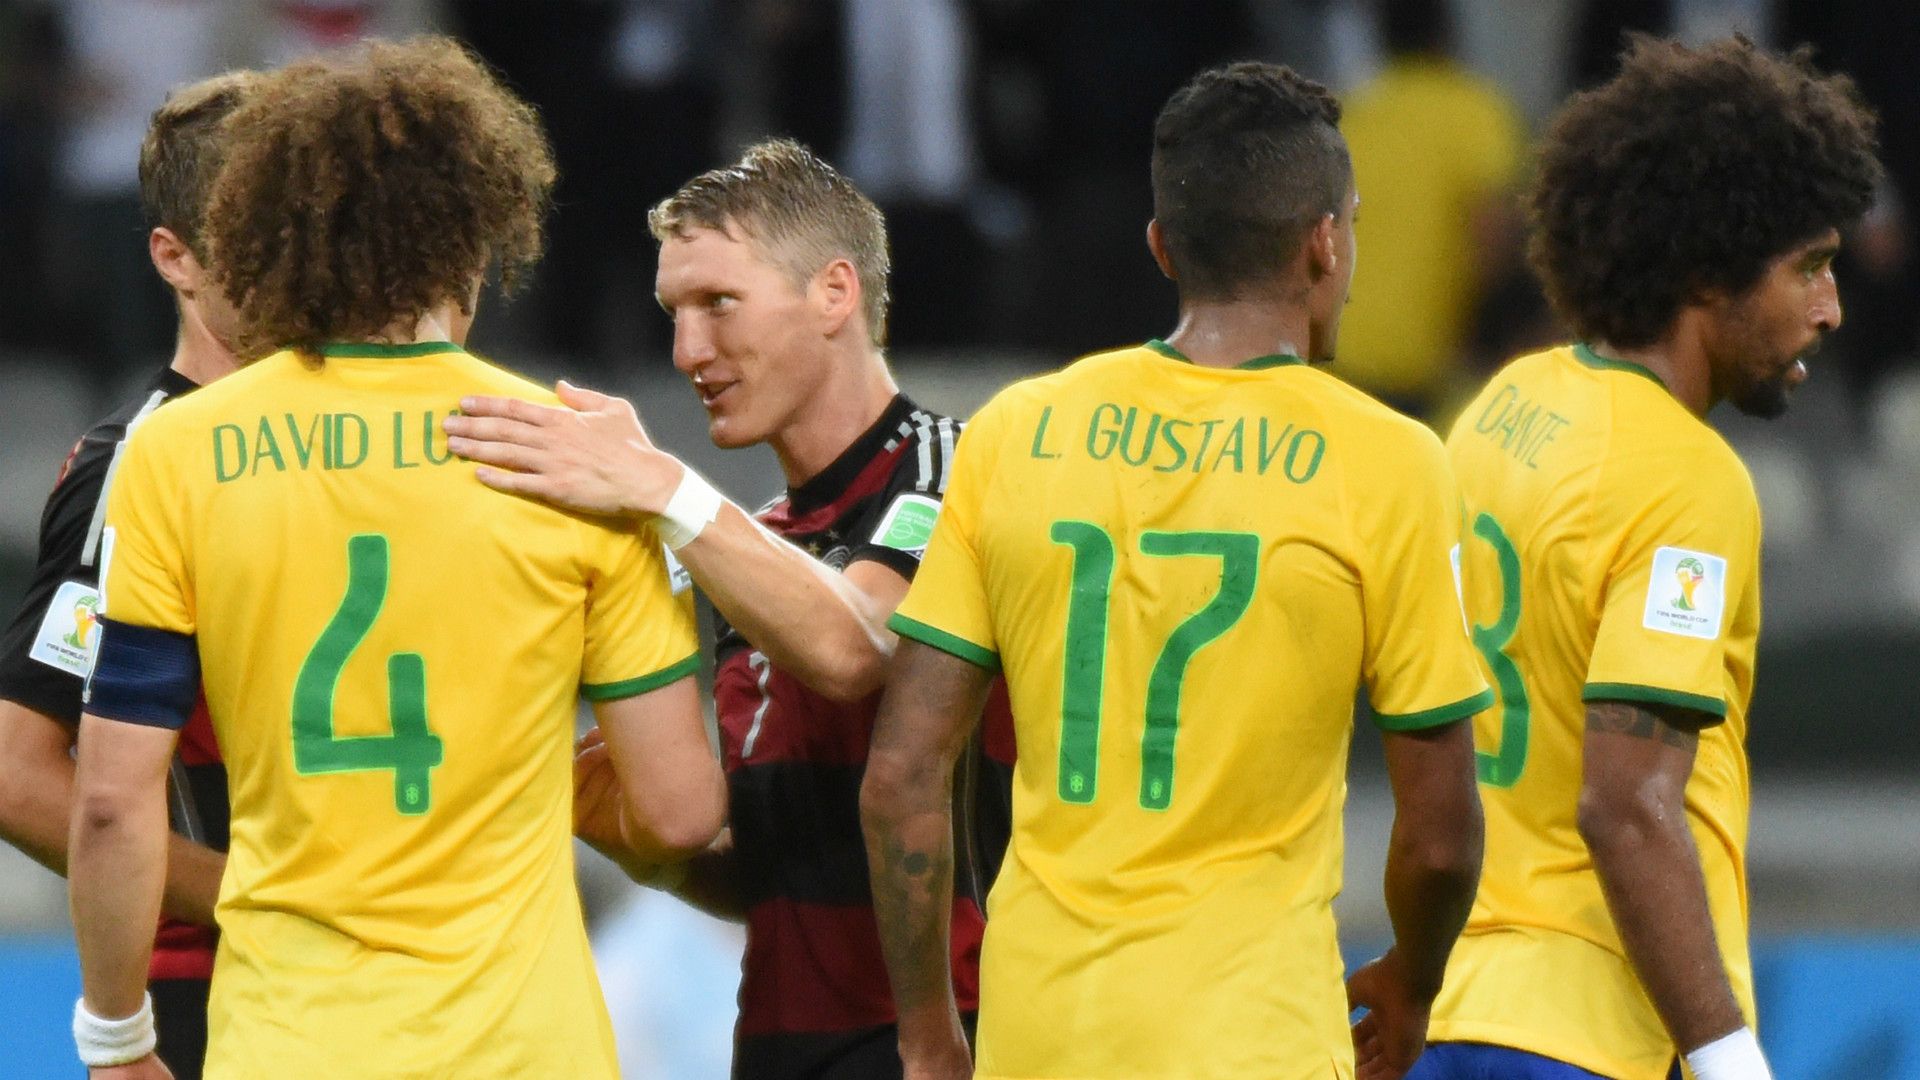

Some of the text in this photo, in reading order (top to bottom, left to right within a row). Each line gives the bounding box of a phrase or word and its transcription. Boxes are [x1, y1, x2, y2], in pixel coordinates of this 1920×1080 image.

[213, 410, 468, 483] DAVID LU
[1030, 403, 1326, 484] L. GUSTAVO
[1476, 383, 1571, 469] DANTE
[292, 532, 443, 816] 4
[1050, 519, 1261, 812] 17
[1461, 511, 1530, 788] 3
